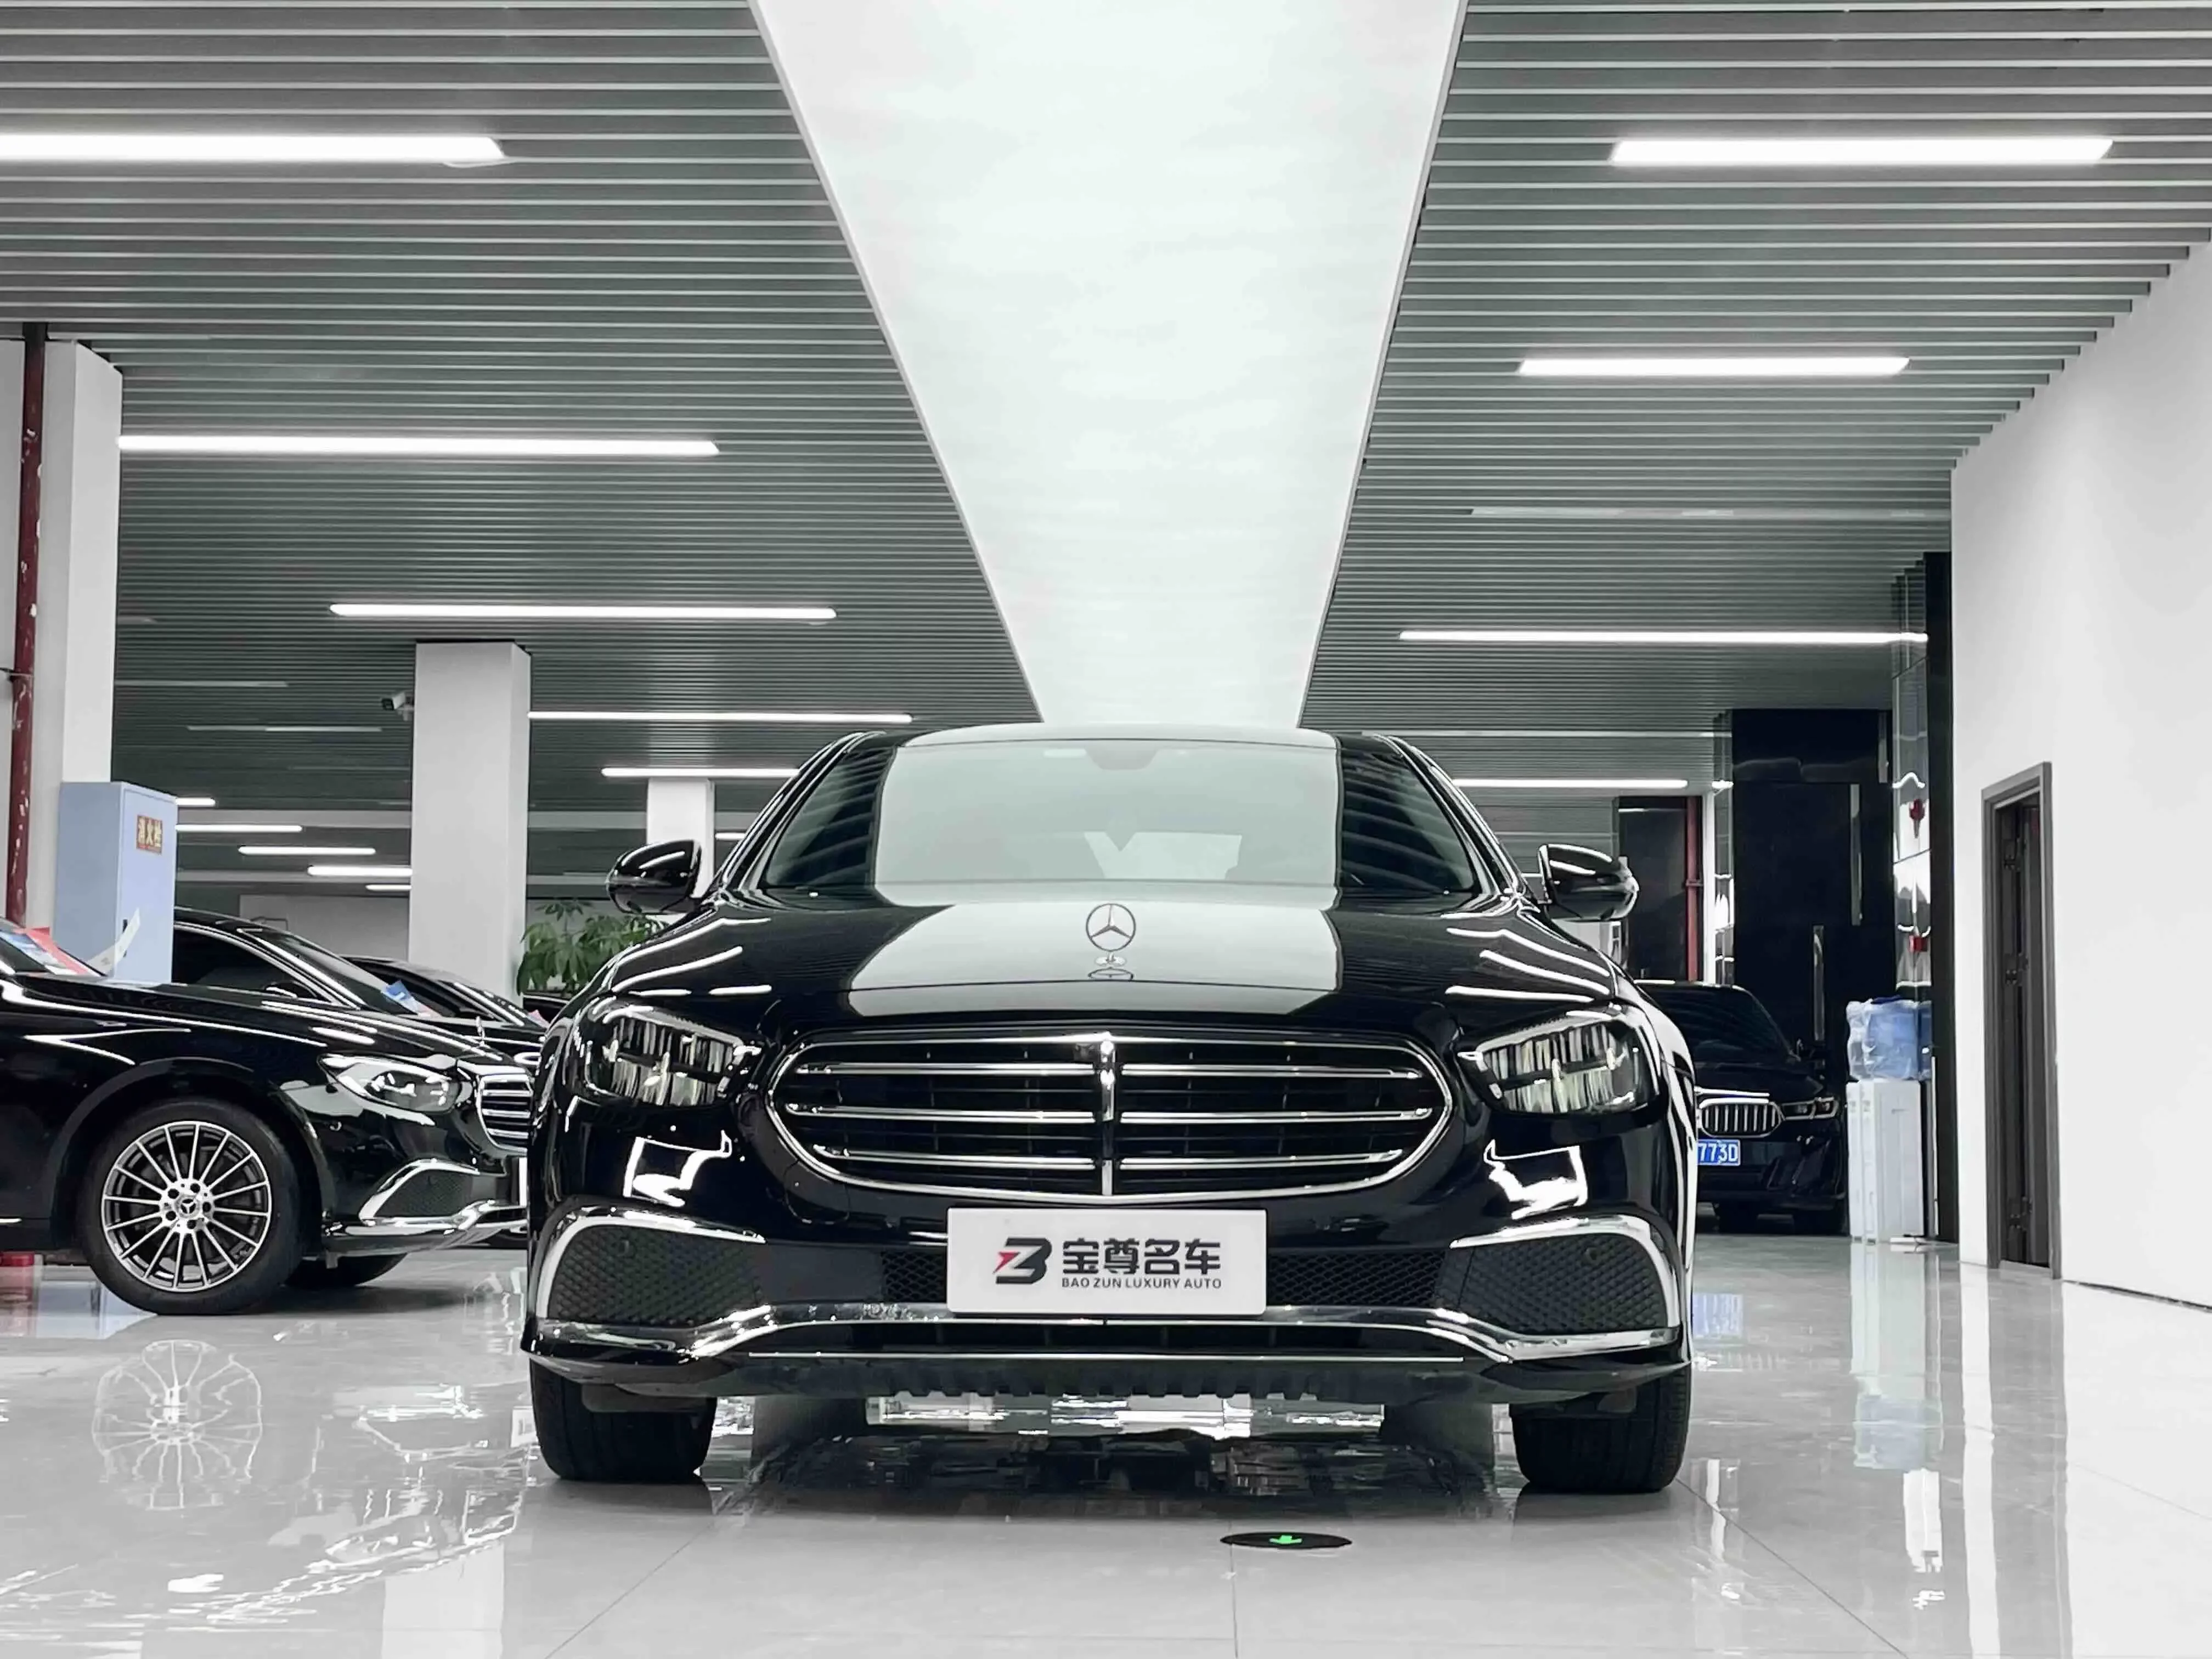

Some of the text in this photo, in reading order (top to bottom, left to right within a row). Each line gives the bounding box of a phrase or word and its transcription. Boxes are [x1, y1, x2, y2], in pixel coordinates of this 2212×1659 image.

[1062, 1237, 1221, 1276] 宝尊名车
[1062, 1277, 1221, 1289] BAO ZUN LUXURY AUTO
